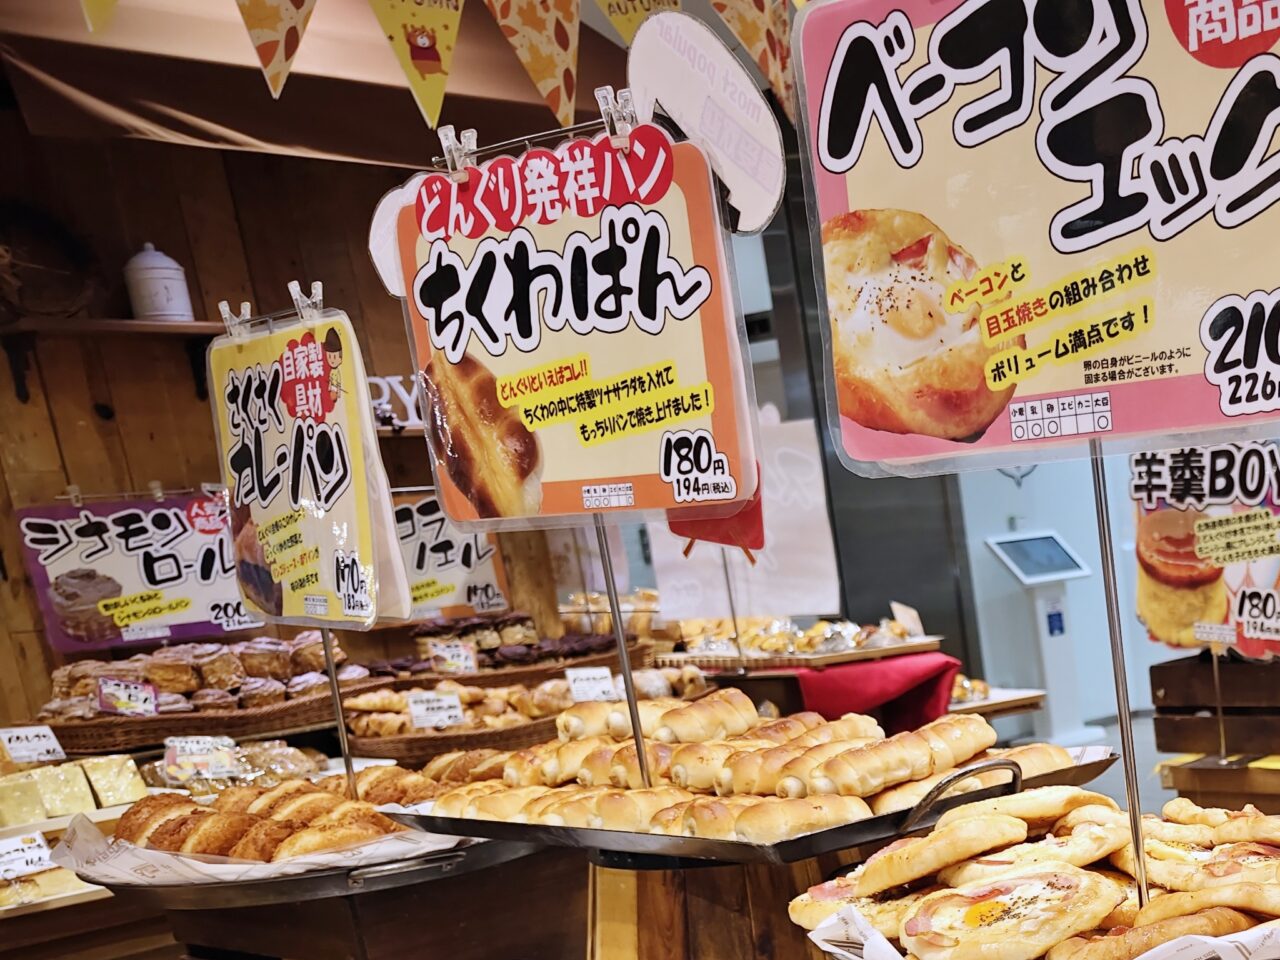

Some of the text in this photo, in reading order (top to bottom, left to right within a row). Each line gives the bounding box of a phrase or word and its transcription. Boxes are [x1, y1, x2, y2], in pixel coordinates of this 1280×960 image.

[826, 0, 1134, 163] ベーコン
[419, 139, 667, 240] どんぐり発祥パン
[419, 217, 703, 353] ちくわぱん
[950, 262, 1026, 307] ベーコンと
[985, 255, 1150, 338] 目玉焼きの組み合わせ
[283, 341, 324, 381] 自家製
[1083, 347, 1192, 371] 卵の白身がビニールのように
[1084, 363, 1180, 385] 固まる場合がございます。
[227, 369, 281, 430] さくさく
[295, 381, 322, 417] 具材
[524, 366, 674, 425] ちくわの中に特製ツナサラダを入れて
[662, 436, 725, 477] 180円
[25, 511, 189, 562] シナモン
[143, 538, 236, 586] ロール
